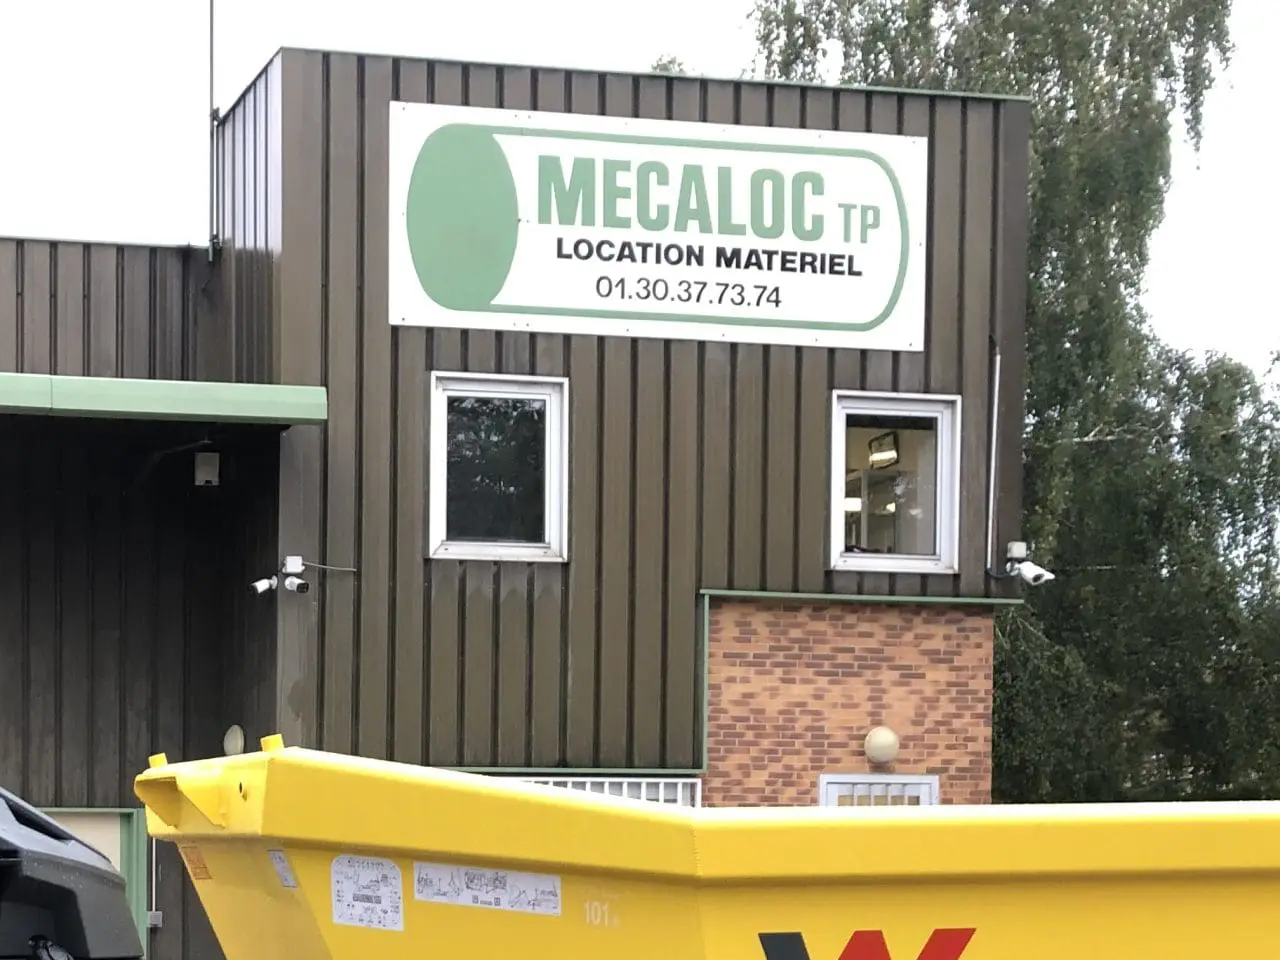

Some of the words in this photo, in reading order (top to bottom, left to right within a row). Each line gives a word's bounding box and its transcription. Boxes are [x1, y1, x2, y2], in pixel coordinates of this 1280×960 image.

[538, 155, 825, 242] MECALOC
[838, 203, 881, 244] TP
[556, 237, 704, 266] LOCATION
[715, 247, 863, 277] MATERIEL
[596, 275, 782, 308] 01.30.37.73.74
